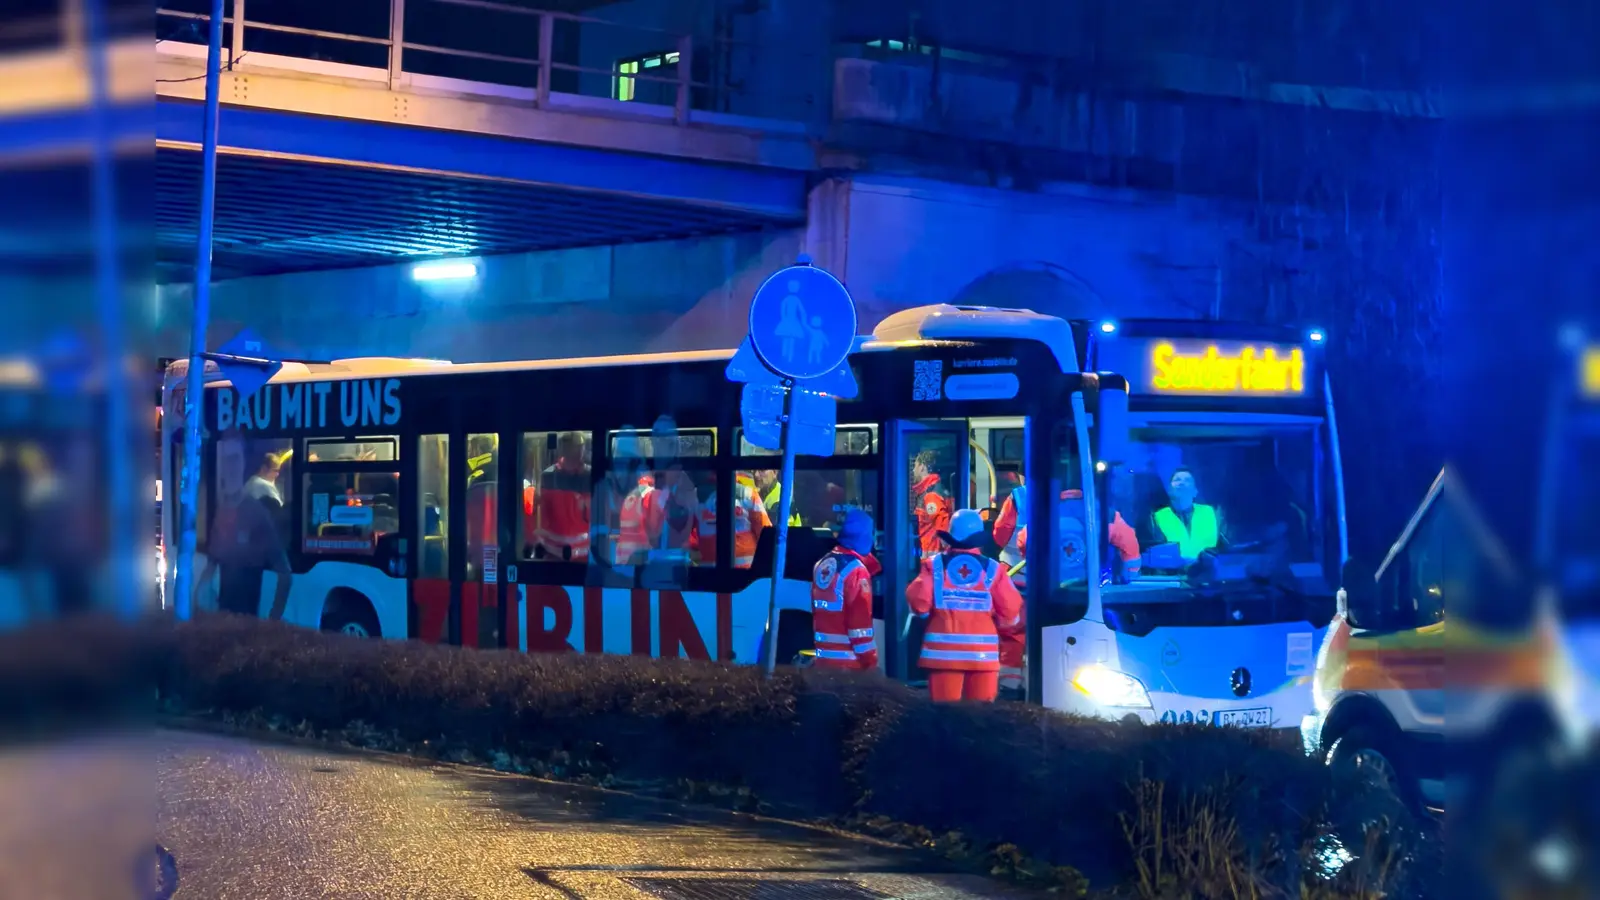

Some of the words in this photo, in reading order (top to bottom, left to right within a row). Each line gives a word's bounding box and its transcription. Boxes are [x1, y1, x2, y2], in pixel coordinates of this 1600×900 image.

[1153, 341, 1304, 391] Sonderfahrt
[217, 384, 272, 432] BAU
[280, 381, 332, 430] MIT
[340, 378, 401, 428] UNS
